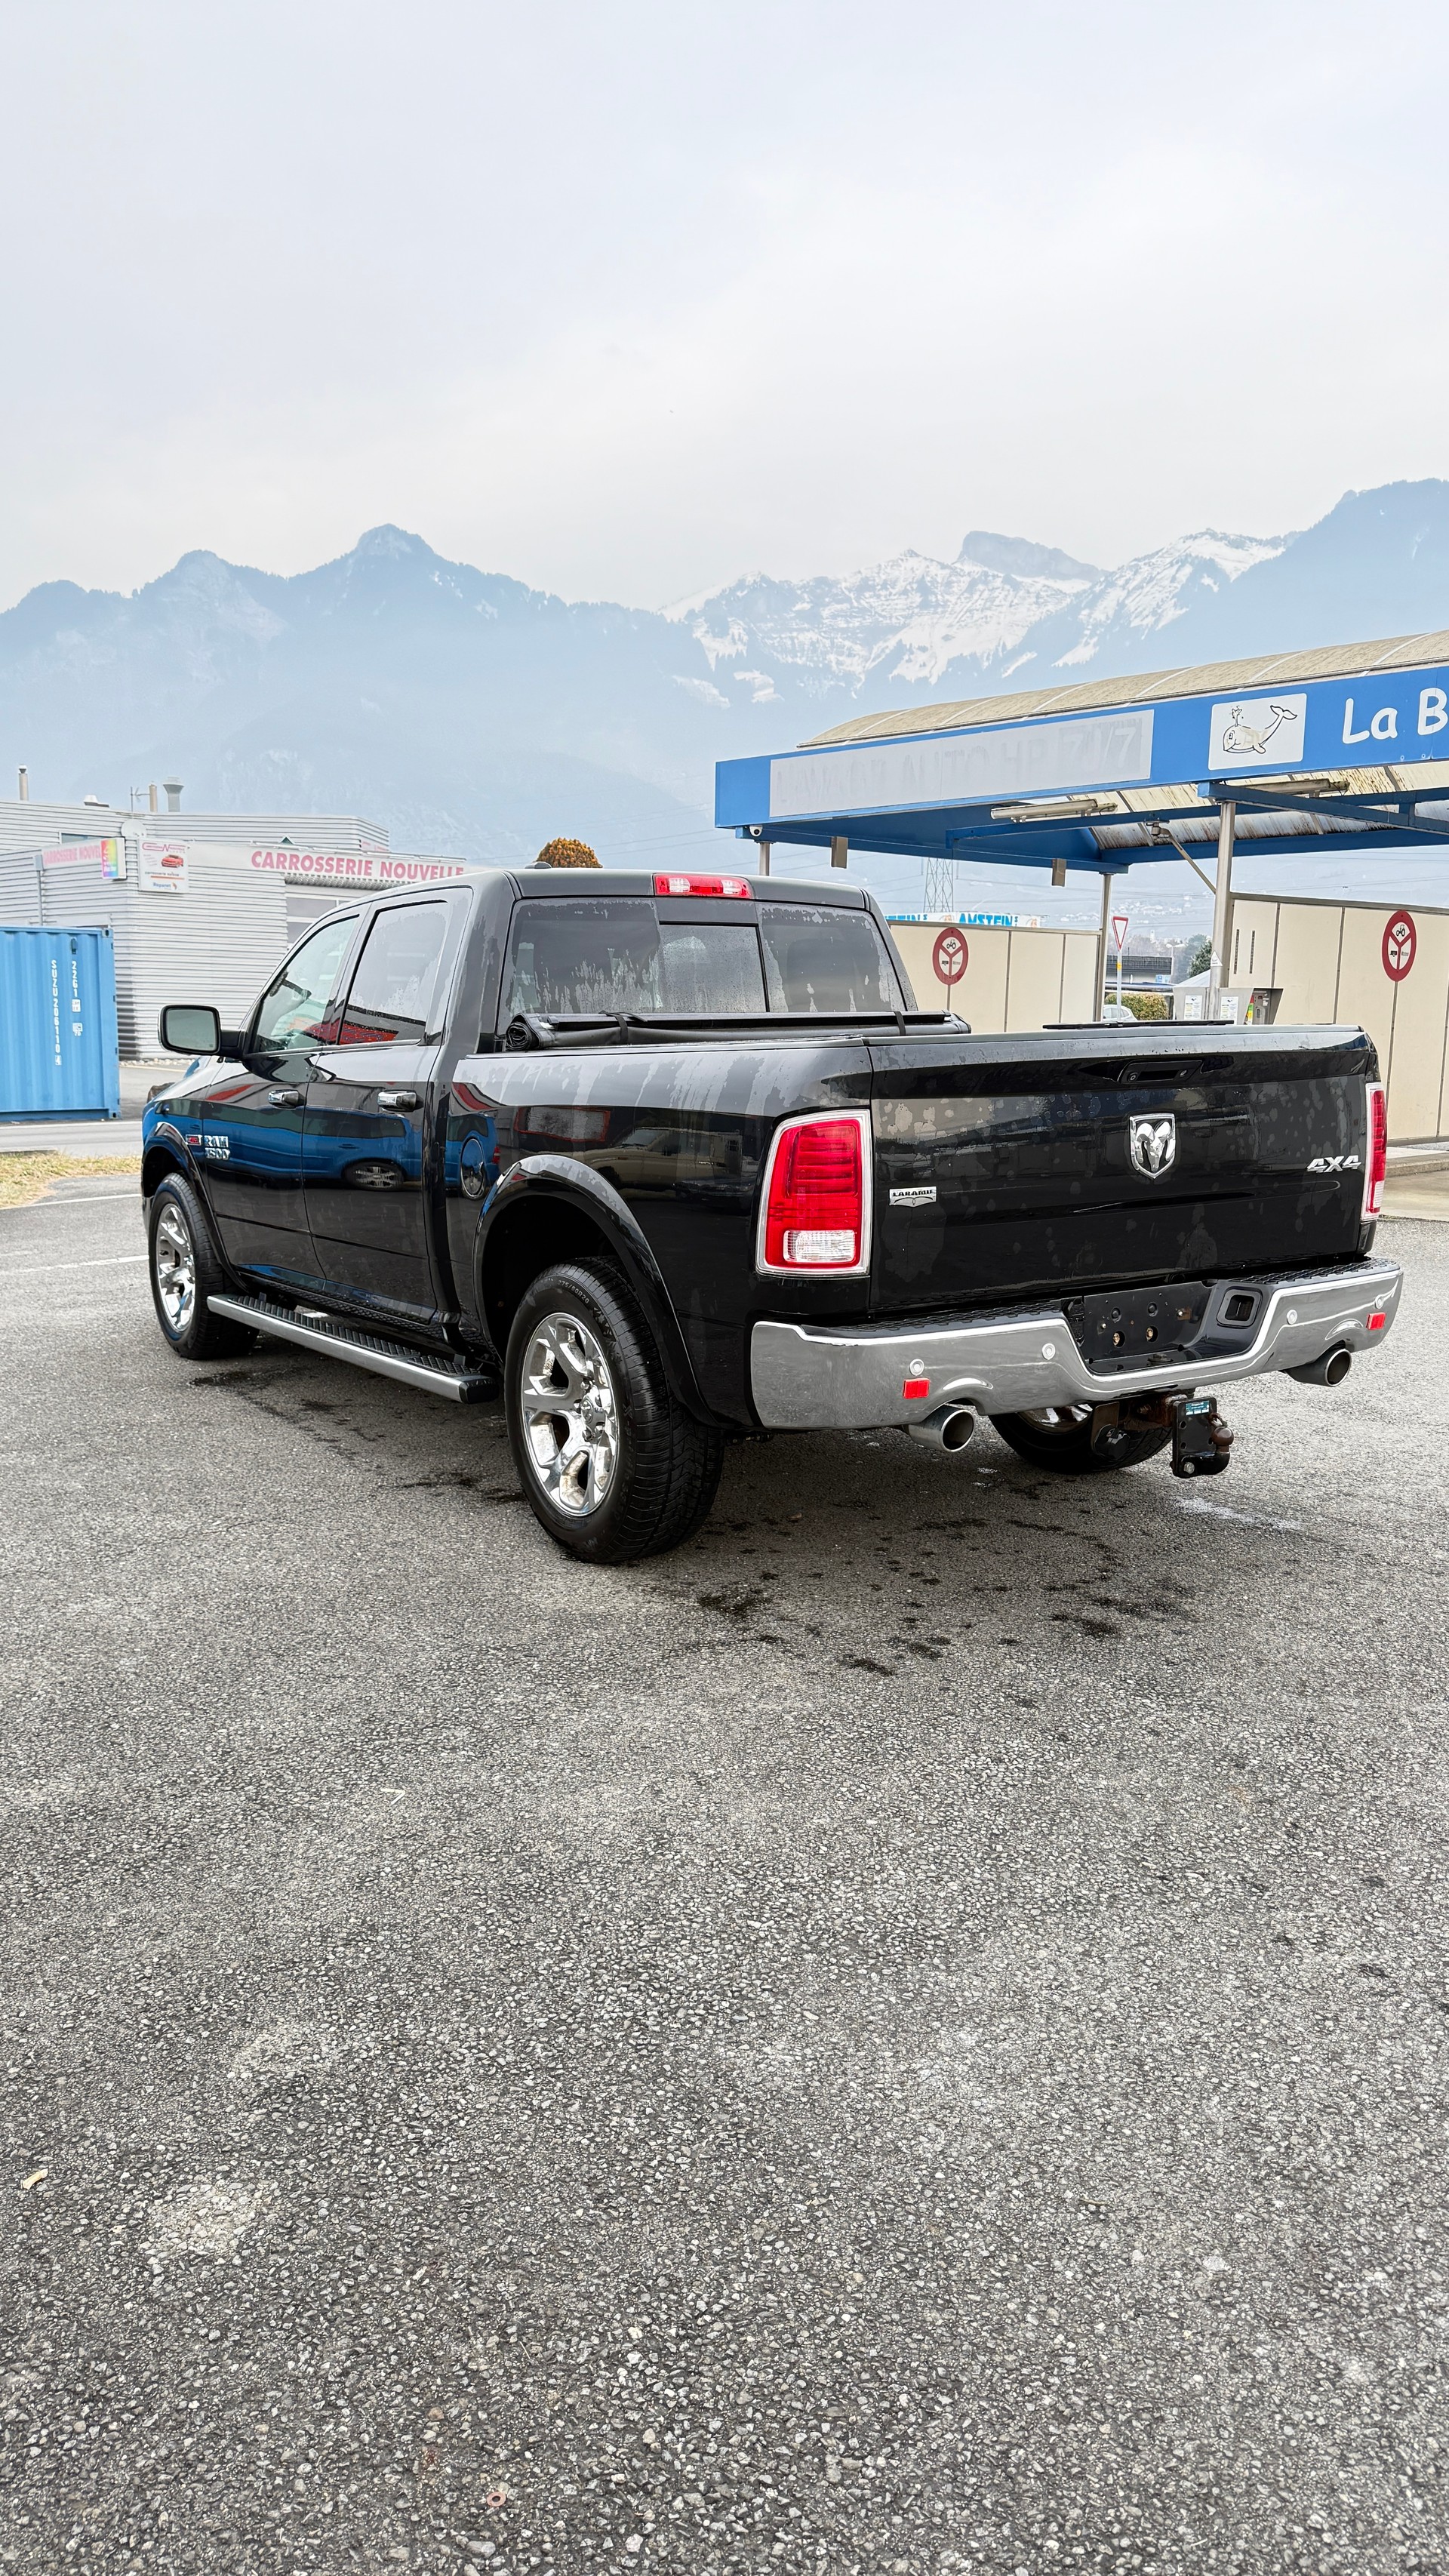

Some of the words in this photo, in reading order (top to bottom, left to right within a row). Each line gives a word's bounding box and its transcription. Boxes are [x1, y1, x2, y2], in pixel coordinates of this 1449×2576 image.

[1343, 697, 1398, 744] La
[251, 851, 374, 876] CARROSSERIE
[204, 1134, 229, 1148] RAM
